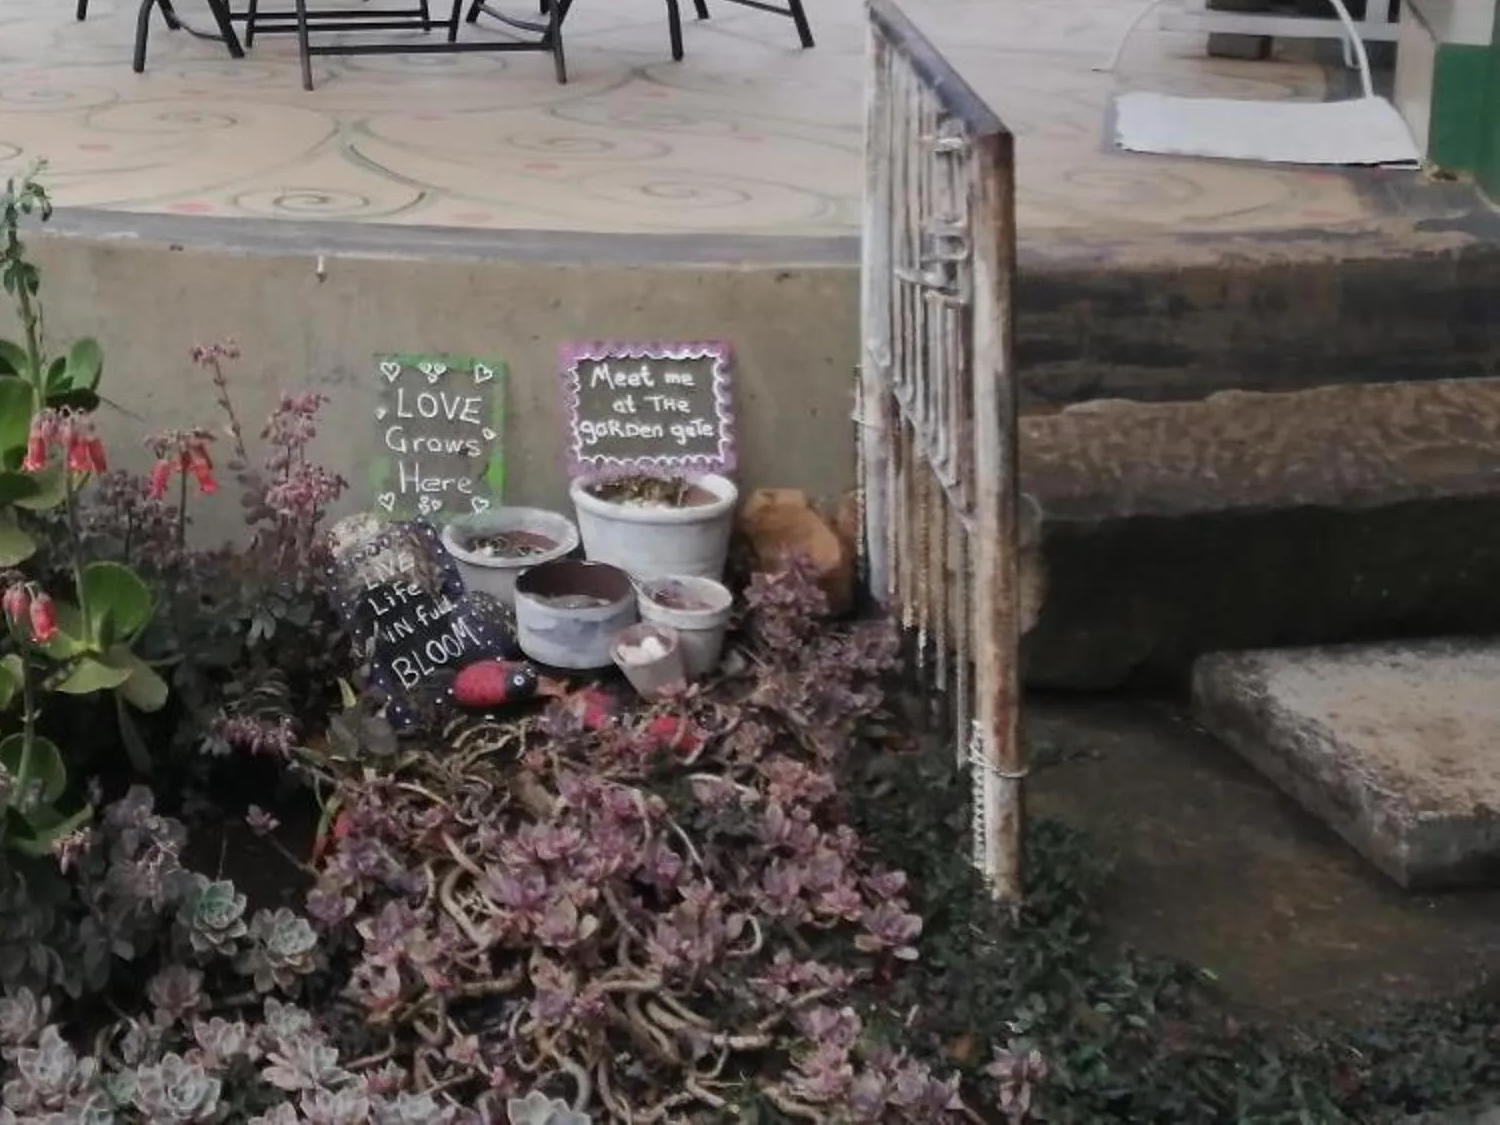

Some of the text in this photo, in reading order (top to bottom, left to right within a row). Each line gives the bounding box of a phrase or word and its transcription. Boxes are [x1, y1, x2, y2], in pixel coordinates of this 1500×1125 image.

[590, 363, 696, 389] Meet me
[396, 387, 483, 424] LOVE
[611, 394, 637, 414] at
[385, 426, 482, 457] Grows
[398, 461, 474, 494] Here
[391, 616, 481, 691] BLOOM
